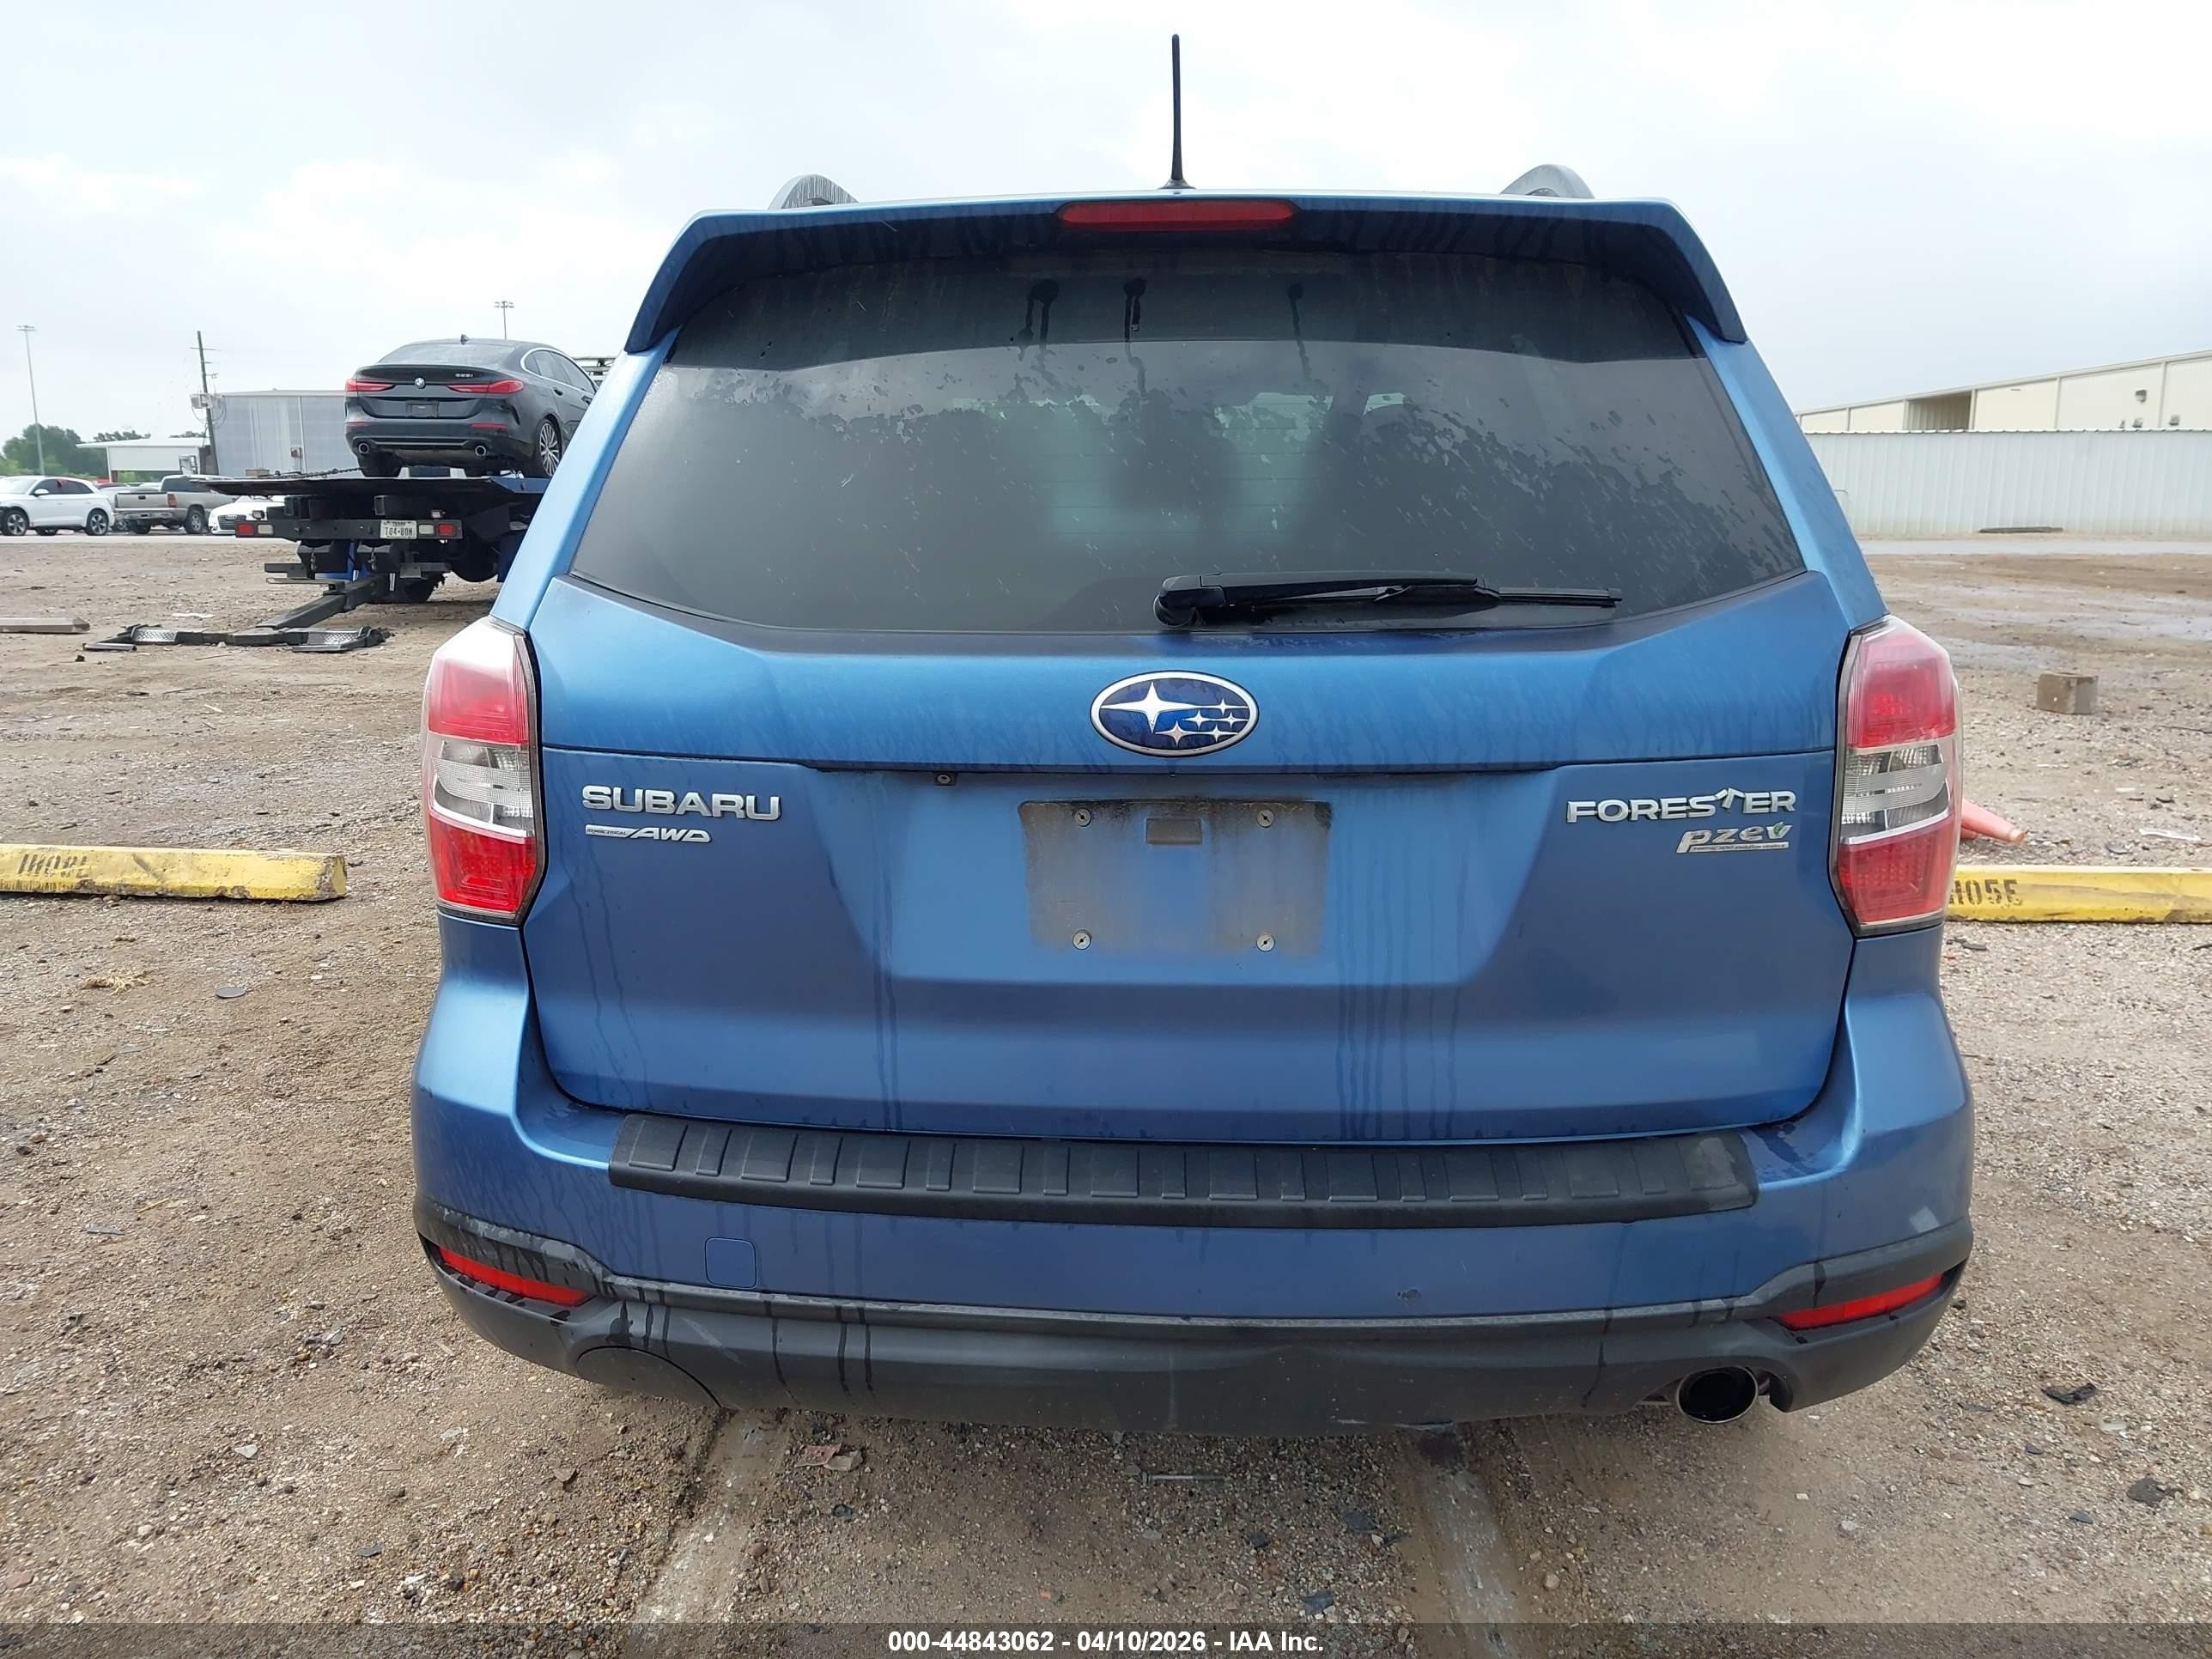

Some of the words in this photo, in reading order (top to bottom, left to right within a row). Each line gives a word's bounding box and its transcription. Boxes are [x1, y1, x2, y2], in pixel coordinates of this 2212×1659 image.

[582, 785, 781, 821] SUBARU
[1566, 787, 1796, 823] FORESTER
[630, 826, 712, 842] AWD
